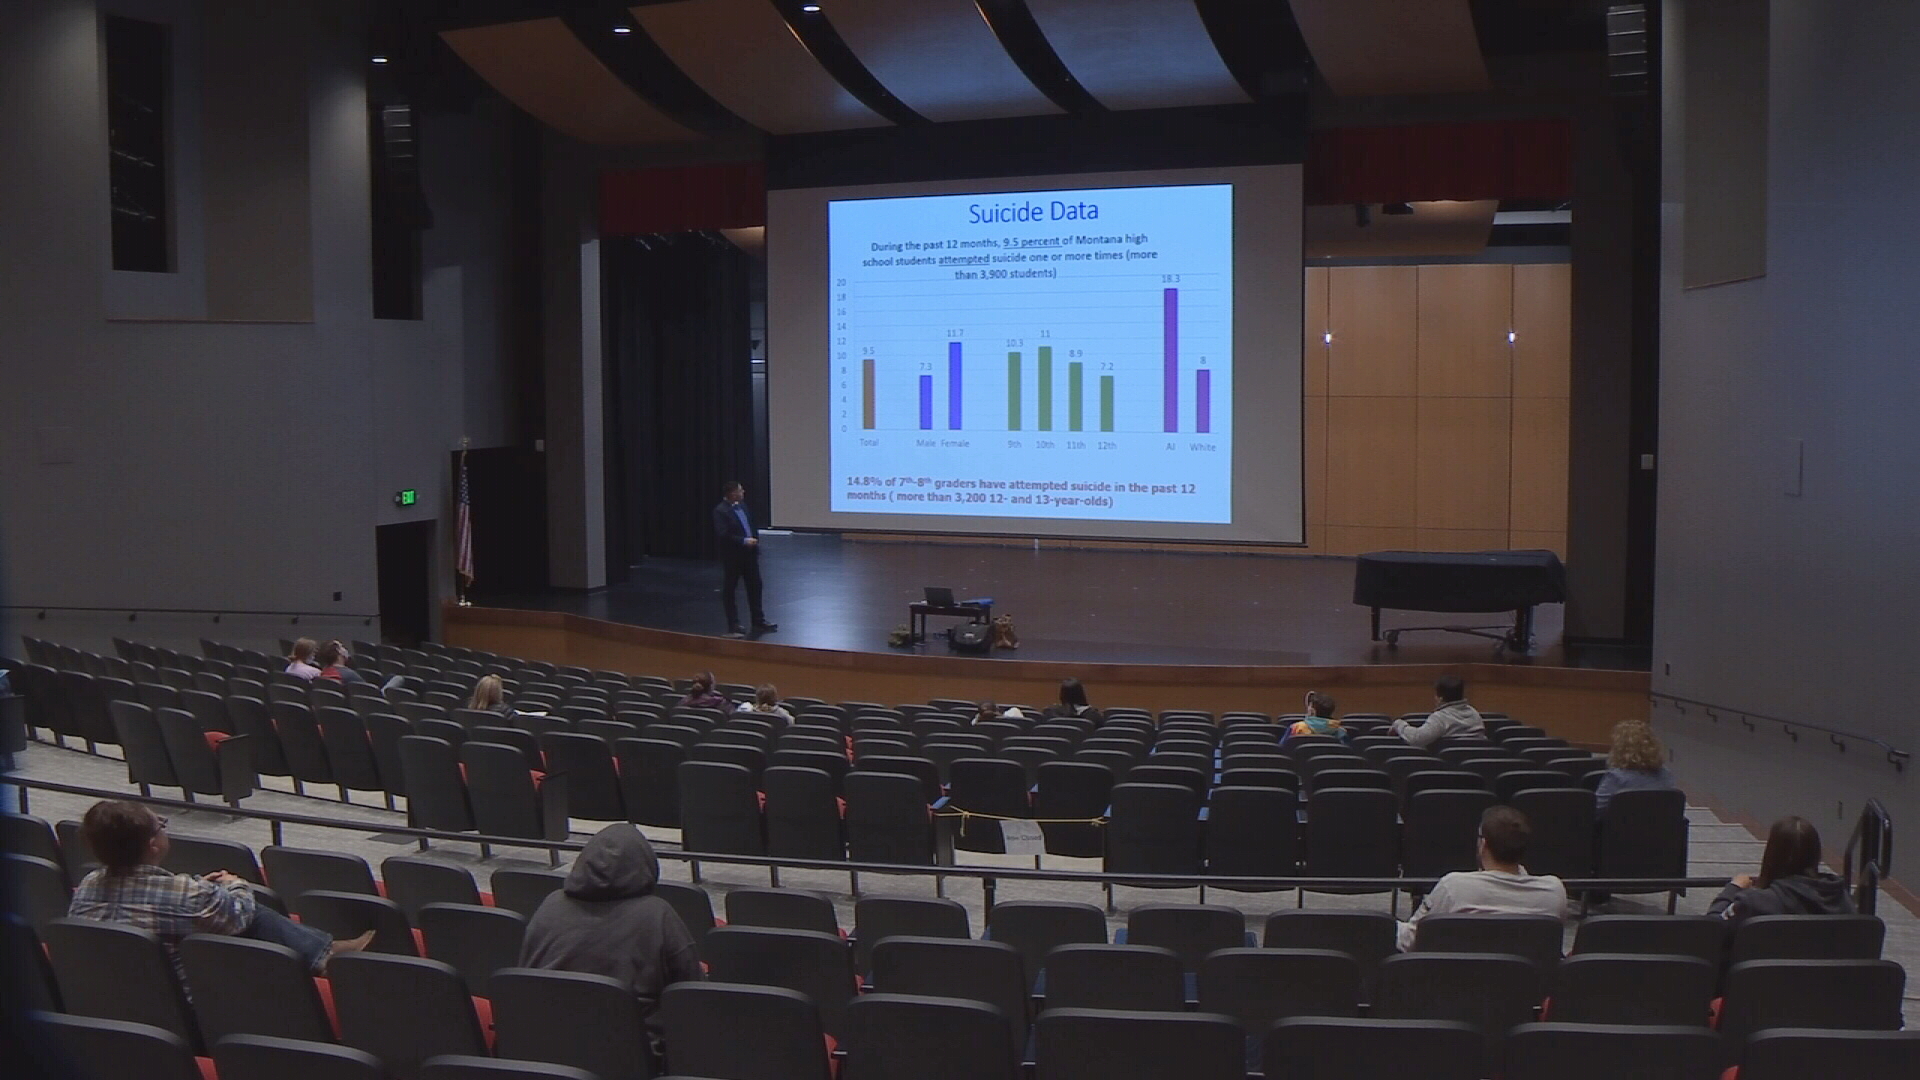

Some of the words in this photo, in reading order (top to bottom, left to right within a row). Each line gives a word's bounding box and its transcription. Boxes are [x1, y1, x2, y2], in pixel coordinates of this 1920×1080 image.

[969, 201, 1044, 224] Suicide
[1050, 200, 1099, 221] Data
[871, 241, 903, 253] During
[905, 241, 921, 251] the
[923, 241, 944, 251] past
[947, 240, 958, 249] 12
[960, 238, 1001, 248] months,
[1003, 237, 1019, 248] 9.5
[1021, 237, 1060, 248] percent
[1062, 235, 1074, 246] of
[1075, 235, 1123, 245] Montana
[1125, 233, 1149, 245] high
[862, 257, 893, 267] school
[895, 256, 937, 266] students
[938, 253, 990, 265] attempted
[992, 251, 1027, 263] suicide
[1029, 253, 1049, 262] one
[1051, 253, 1063, 262] or
[1064, 252, 1093, 261] more
[1094, 250, 1123, 261] times
[1126, 249, 1159, 261] (more
[955, 270, 979, 280] than
[980, 269, 1008, 280] 3,900
[1010, 267, 1057, 279] students)
[1161, 274, 1181, 284] 18.3
[947, 329, 964, 338] 11.7
[1040, 330, 1051, 338] 11
[1006, 339, 1024, 348] 10.3
[1068, 349, 1083, 358] 8.9
[919, 362, 933, 371] 7.3
[1100, 362, 1114, 371] 7.2
[859, 438, 880, 447] Total
[916, 439, 937, 448] Male
[940, 439, 970, 448] Female
[1007, 440, 1022, 449] 9th
[1036, 440, 1055, 449] 10th
[1067, 440, 1087, 450] 11th
[1097, 441, 1118, 450] 12th
[1189, 442, 1217, 452] White
[847, 476, 882, 486] 14.8%
[885, 477, 897, 487] of
[934, 477, 976, 490] graders
[979, 479, 1006, 489] have
[1008, 480, 1068, 492] attempted
[1070, 481, 1112, 492] suicide
[1114, 481, 1126, 492] in
[1128, 482, 1149, 493] the
[1151, 484, 1177, 495] past
[1181, 484, 1196, 494] 12
[847, 490, 886, 500] months
[896, 493, 925, 502] more
[927, 492, 952, 502] than
[955, 493, 986, 504] 3,200
[989, 494, 1008, 504] 12-
[1010, 495, 1032, 504] and
[1035, 495, 1114, 508] 13-year-olds)
